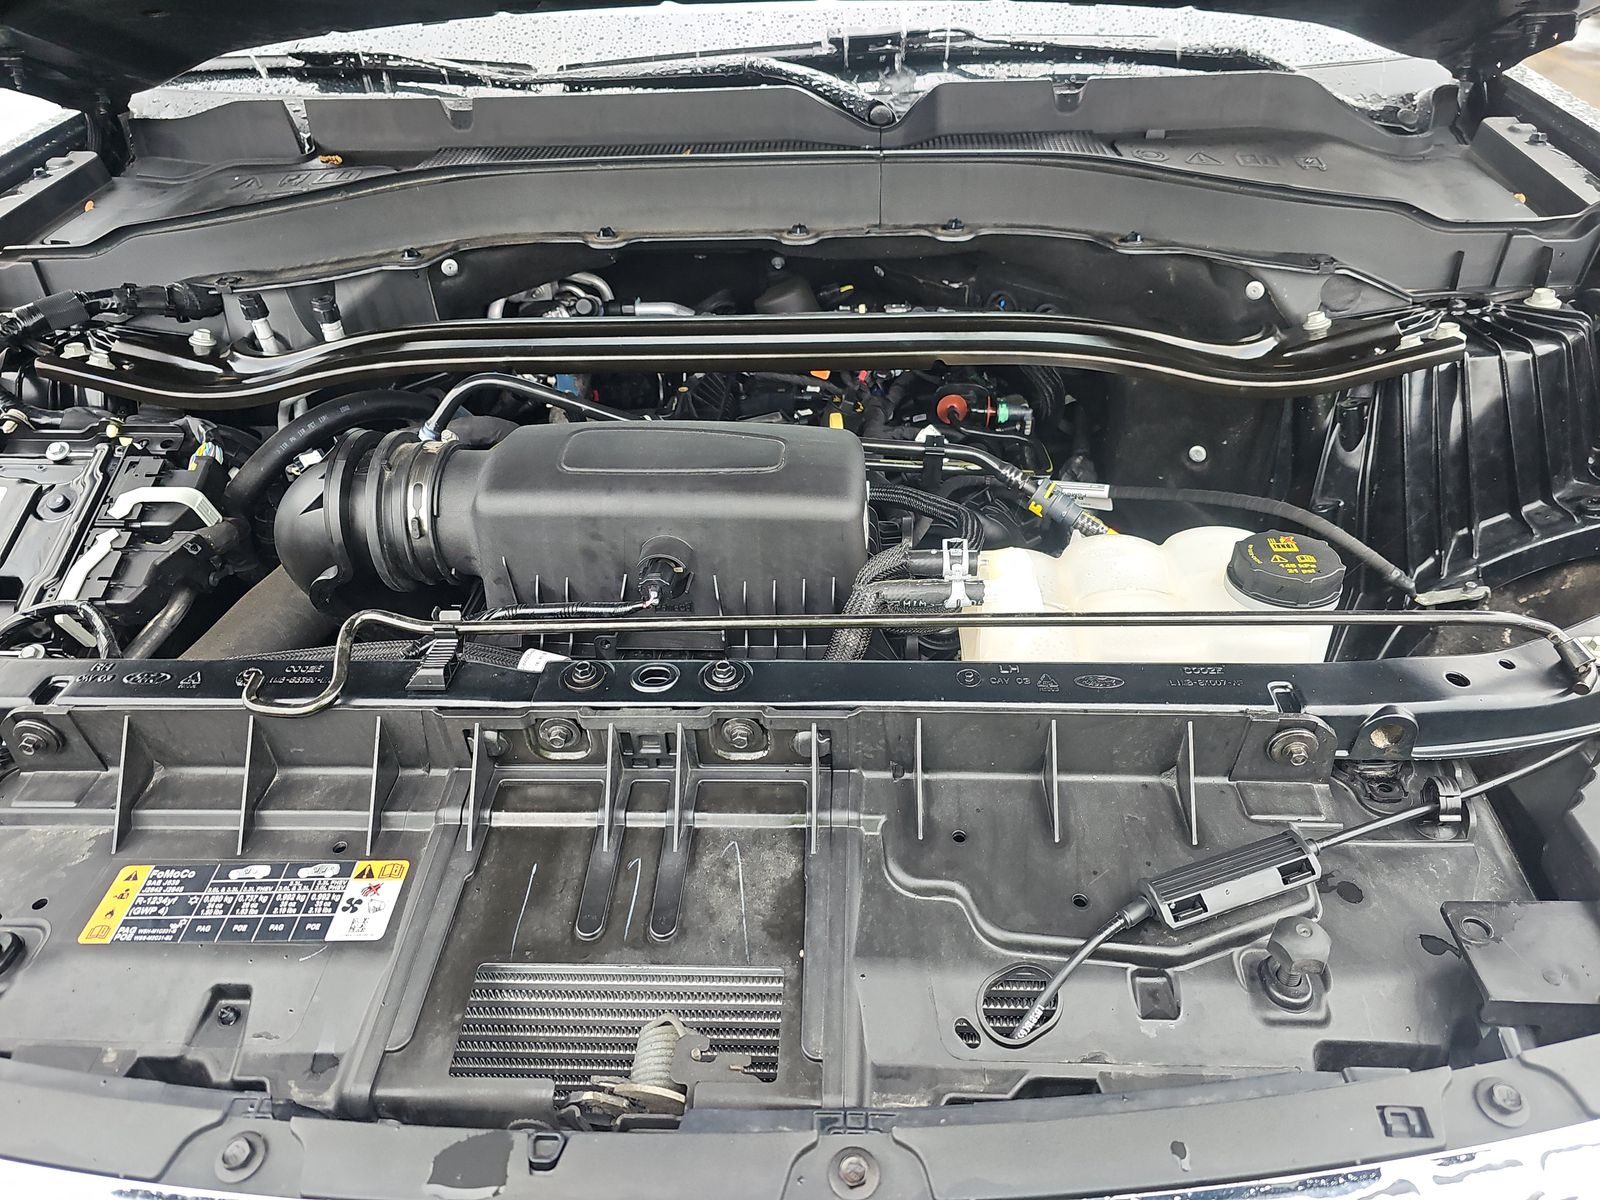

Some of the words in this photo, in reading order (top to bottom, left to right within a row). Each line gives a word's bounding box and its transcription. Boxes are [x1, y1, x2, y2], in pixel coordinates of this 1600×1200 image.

[999, 664, 1020, 674] LH
[149, 869, 196, 879] FoMoCo
[135, 895, 179, 907] R-1234yf
[223, 894, 234, 904] kg
[258, 894, 269, 904] kg
[296, 893, 307, 902] kg
[330, 893, 341, 902] kg
[129, 906, 158, 916] (GWP
[157, 906, 169, 917] 4)
[117, 926, 138, 934] PAG
[195, 924, 212, 932] PAG
[232, 924, 248, 932] POE
[268, 923, 285, 931] PAG
[305, 923, 321, 931] POE
